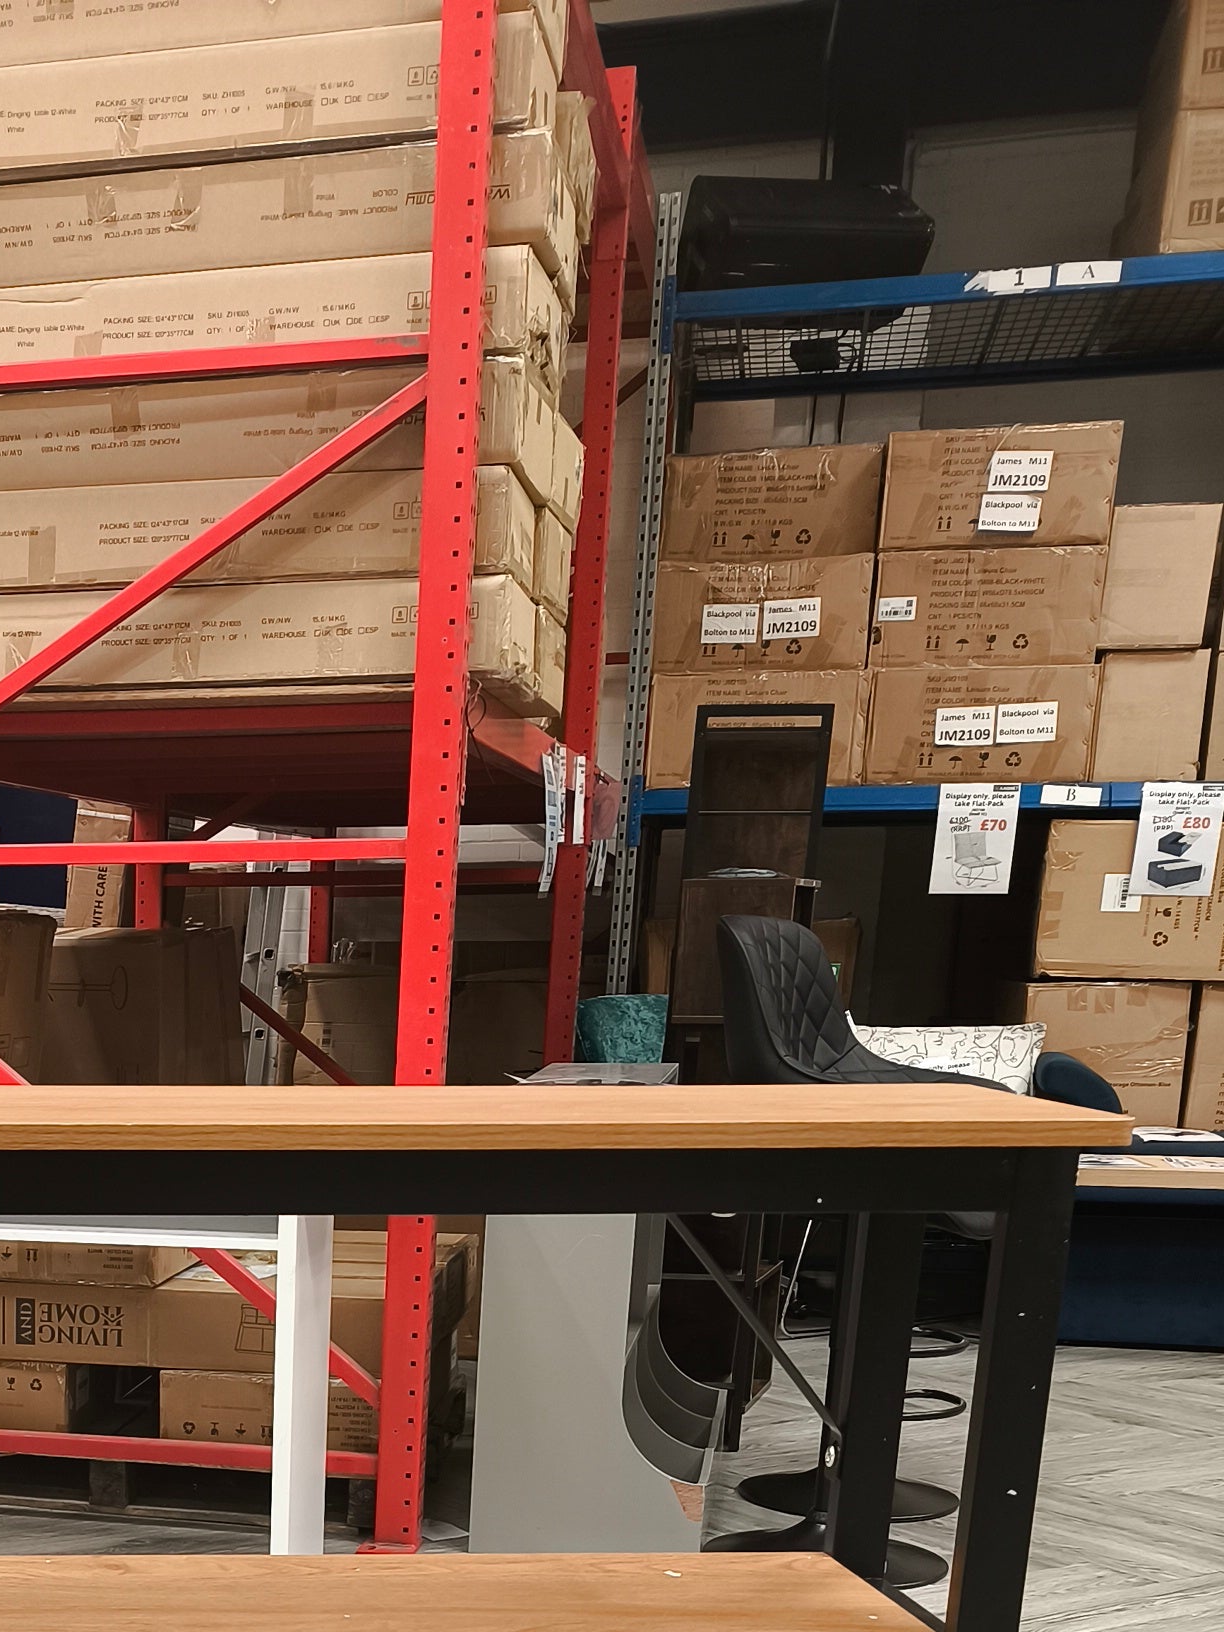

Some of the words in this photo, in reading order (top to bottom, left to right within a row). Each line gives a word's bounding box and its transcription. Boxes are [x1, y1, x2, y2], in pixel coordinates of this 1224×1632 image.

[1082, 264, 1095, 279] A
[1013, 269, 1025, 286] 1
[103, 316, 134, 325] PACKING
[996, 457, 1023, 465] James
[1028, 457, 1048, 465] M11
[992, 474, 1046, 487] JM2109
[985, 501, 1023, 510] Blackpool
[1026, 501, 1038, 509] via
[99, 522, 130, 530] PACKING
[981, 519, 1007, 527] Bolton
[1018, 520, 1036, 528] M11
[99, 537, 131, 545] PRODUCT
[768, 606, 793, 614] James
[798, 603, 817, 611] M11
[707, 610, 742, 619] Blackpool
[739, 628, 755, 636] M11
[766, 620, 817, 635] JM2109
[101, 638, 133, 647] PRODUCT
[940, 714, 966, 722] James
[972, 712, 991, 720] M11
[1001, 709, 1039, 718] Blackpool
[938, 729, 991, 741] JM2109
[999, 728, 1025, 736] Bolton
[1037, 726, 1054, 734] M11
[945, 792, 972, 800] Display
[1066, 788, 1077, 801] B
[979, 819, 1007, 831] £70
[1182, 817, 1211, 829] £80
[95, 866, 108, 897] CARE
[39, 1302, 125, 1326] HOME
[20, 1302, 32, 1342] AND
[38, 1324, 123, 1347] LIVING
